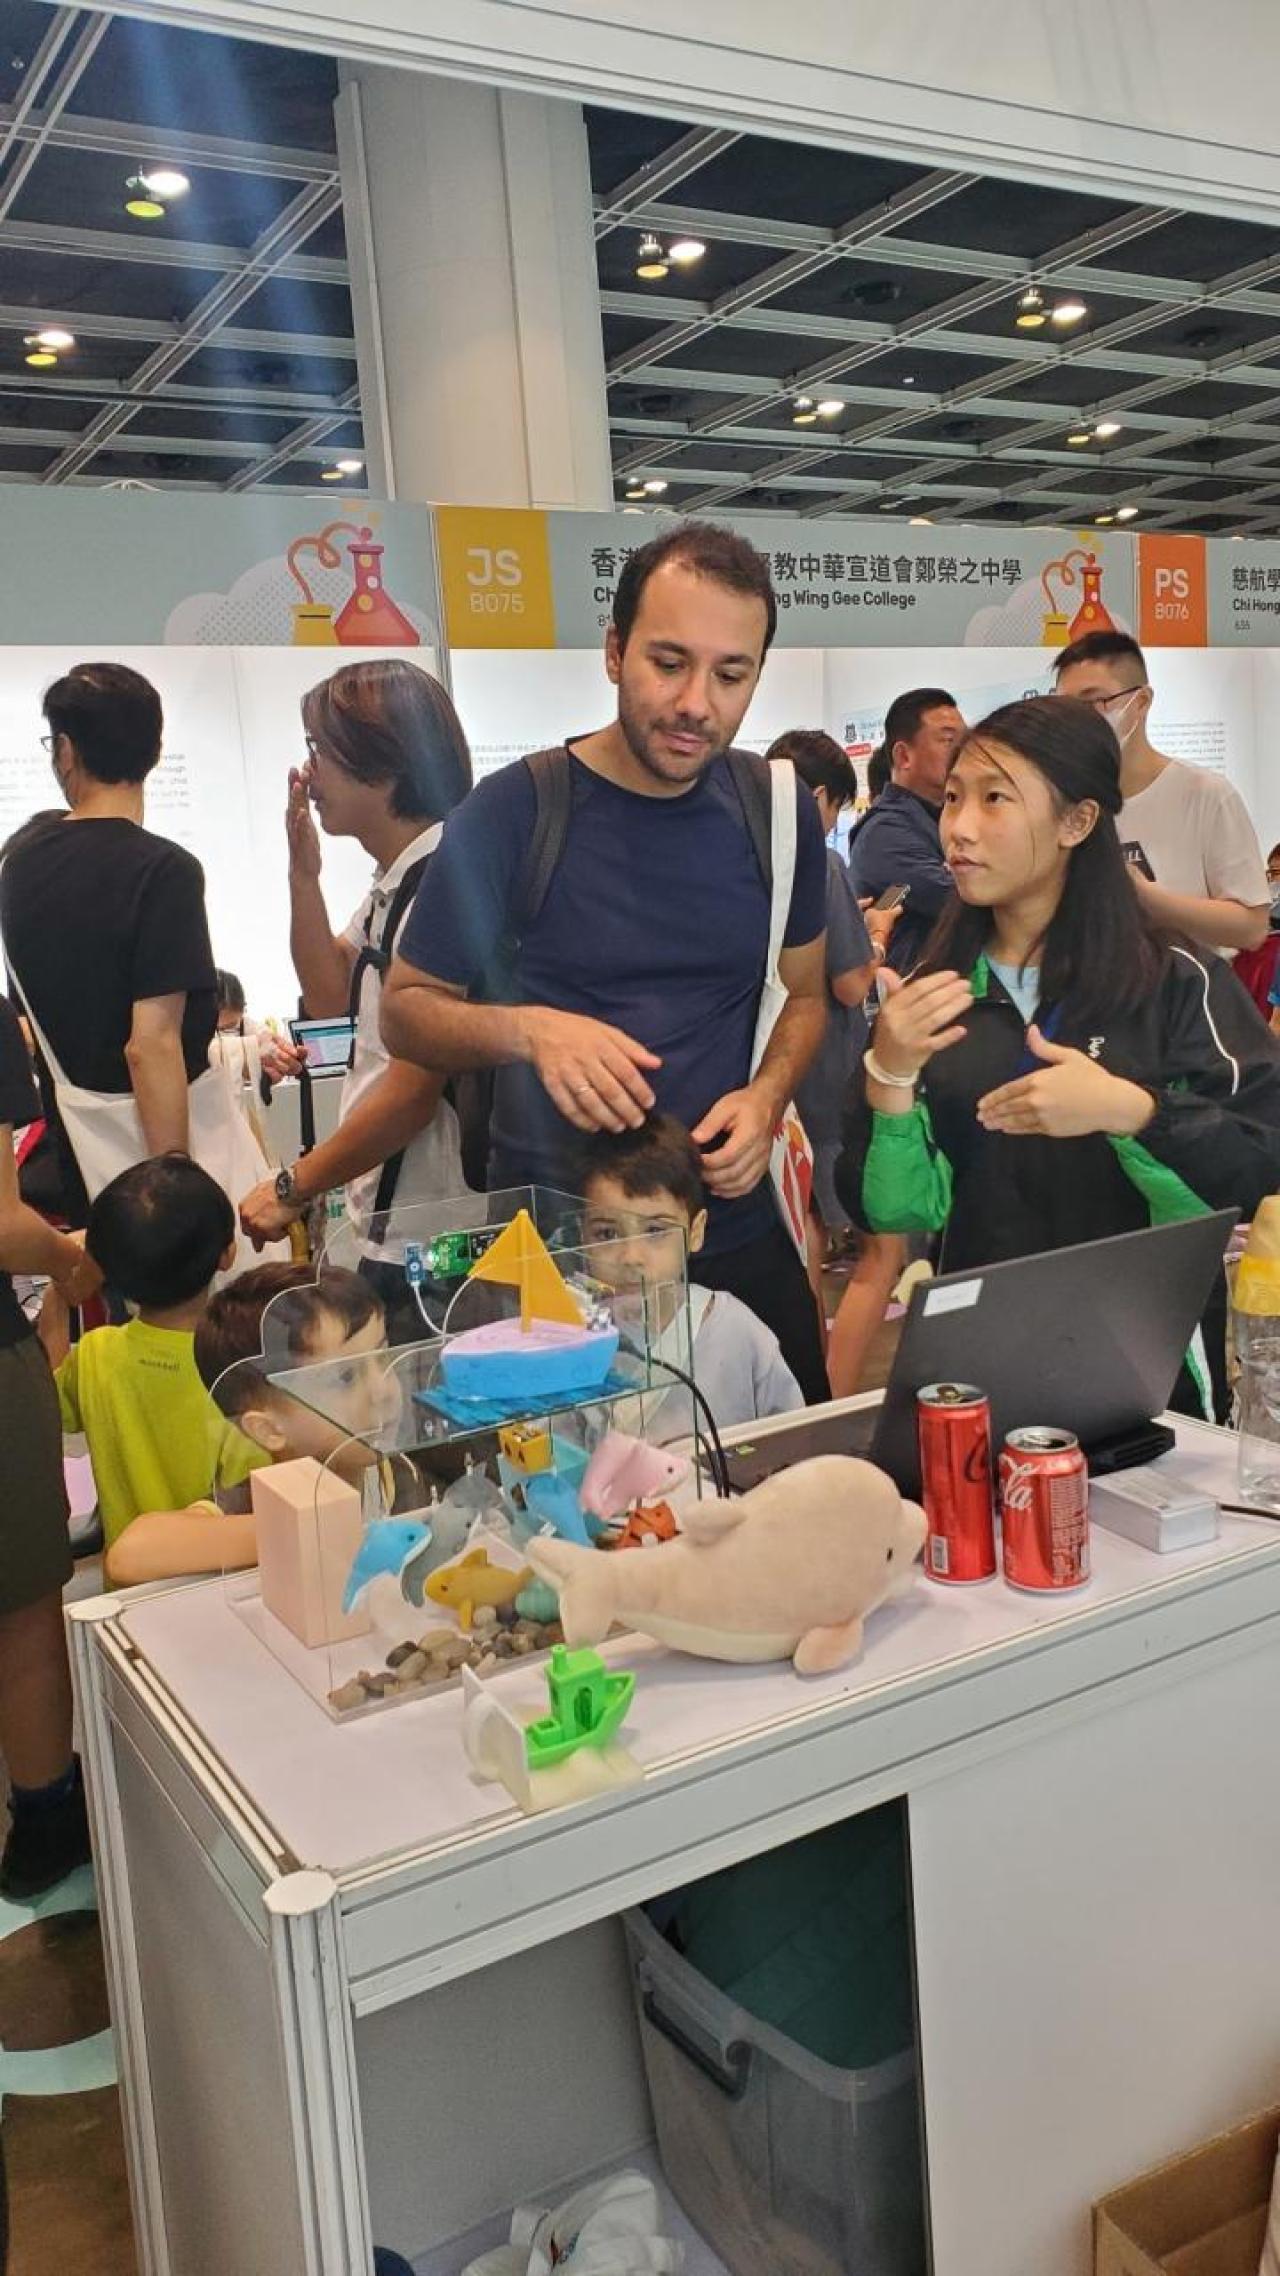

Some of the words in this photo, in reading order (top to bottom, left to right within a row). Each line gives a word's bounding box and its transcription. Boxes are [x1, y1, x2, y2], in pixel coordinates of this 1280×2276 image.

[467, 548, 523, 586] JS
[1154, 568, 1189, 599] PS
[470, 592, 525, 613] B075
[794, 590, 829, 610] Wing
[832, 591, 861, 606] Gee
[863, 591, 917, 610] College
[1233, 600, 1251, 611] Chi
[1253, 600, 1280, 614] Hong
